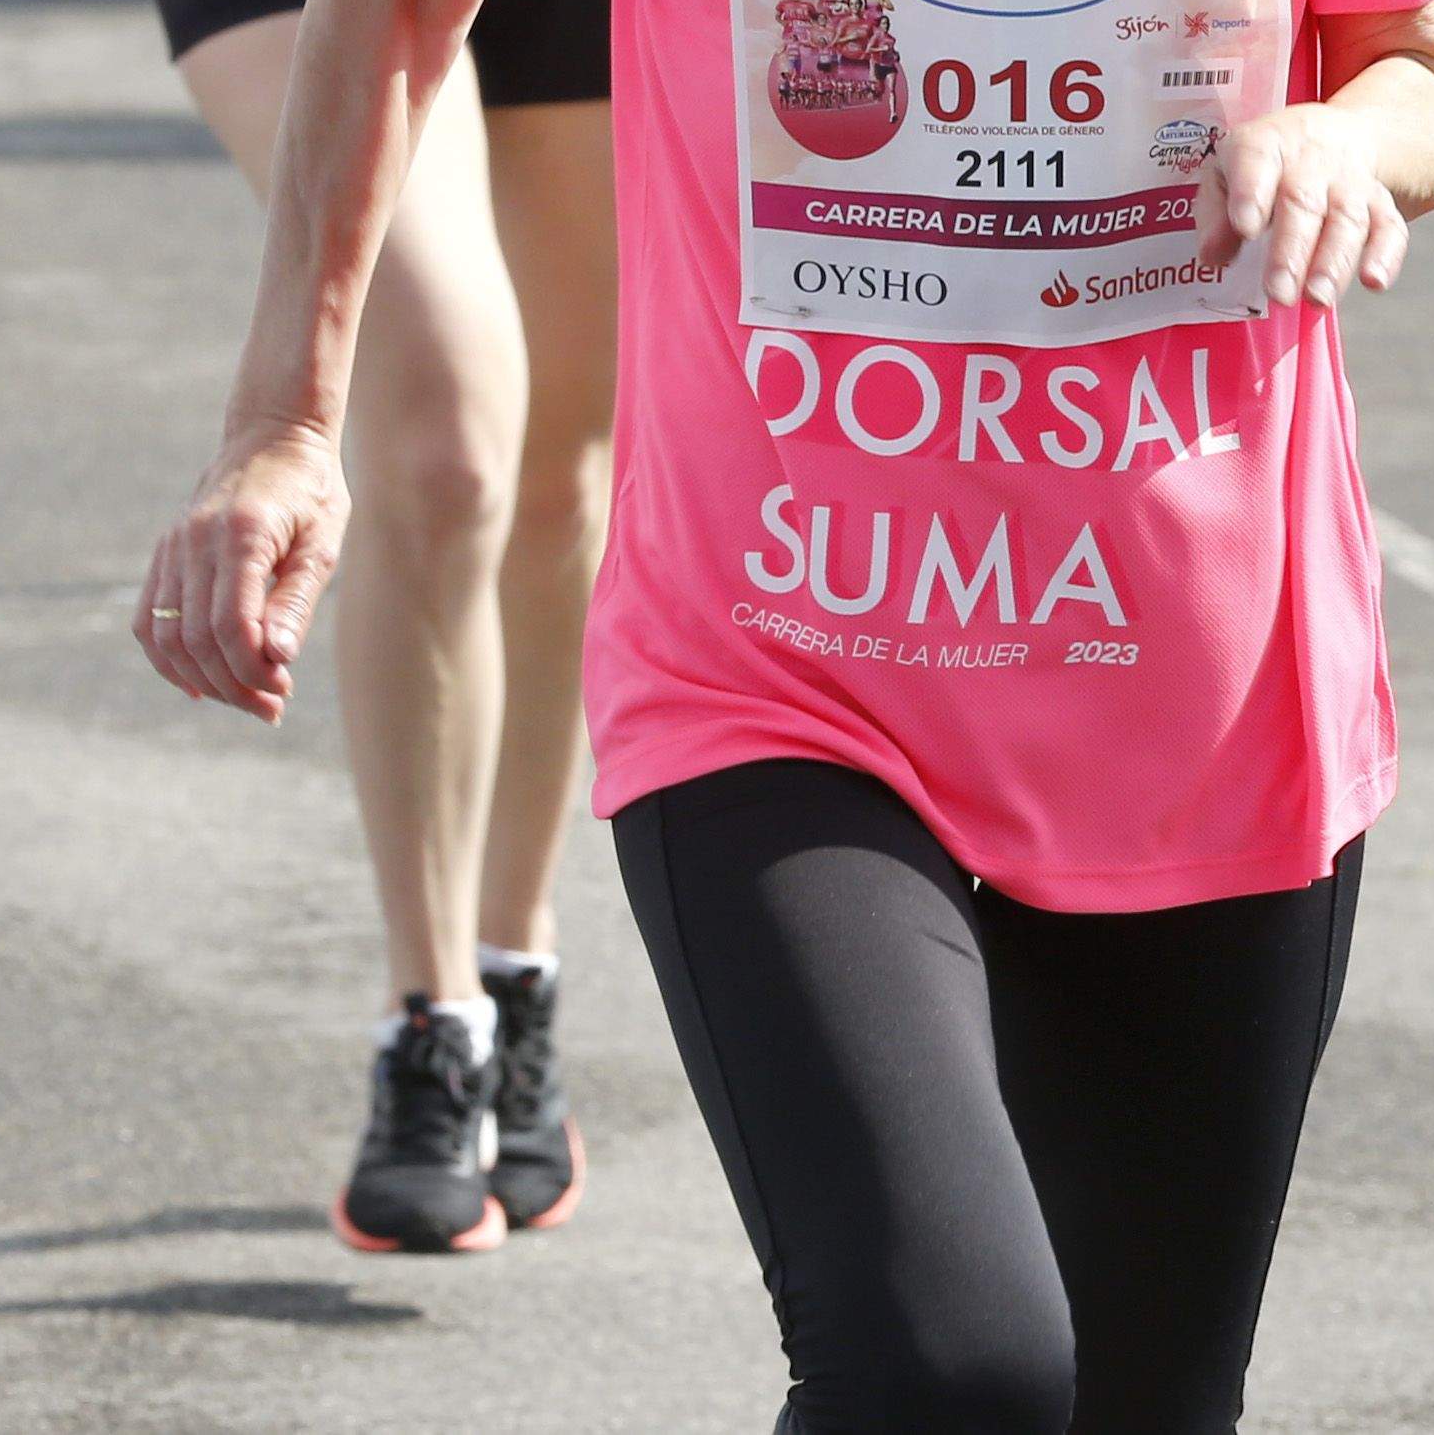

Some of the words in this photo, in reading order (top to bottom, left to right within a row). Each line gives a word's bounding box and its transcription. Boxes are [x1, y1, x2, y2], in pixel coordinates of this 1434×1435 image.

[1212, 18, 1251, 31] Deporte
[922, 58, 1106, 123] 016
[923, 123, 980, 136] TELÉFONO
[981, 125, 1039, 136] VIOLENCIA
[1041, 125, 1056, 136] DE
[1058, 124, 1105, 136] GÉNERO
[1149, 144, 1192, 159] Carrera
[955, 149, 1065, 188] 2111
[806, 200, 946, 233] CARRERA
[954, 212, 995, 237] DE
[1003, 213, 1043, 237] LA
[1051, 206, 1147, 237] MUJER
[1155, 198, 1197, 222] 20
[793, 260, 948, 306] OYSHO
[1085, 257, 1223, 305] Santander
[744, 328, 1241, 472] DORSAL
[744, 483, 1128, 629] SUMA
[731, 601, 844, 658] CARRERA
[851, 635, 892, 661] DE
[896, 643, 930, 668] LA
[936, 643, 1030, 669] MUJER
[1064, 640, 1140, 666] 2023
